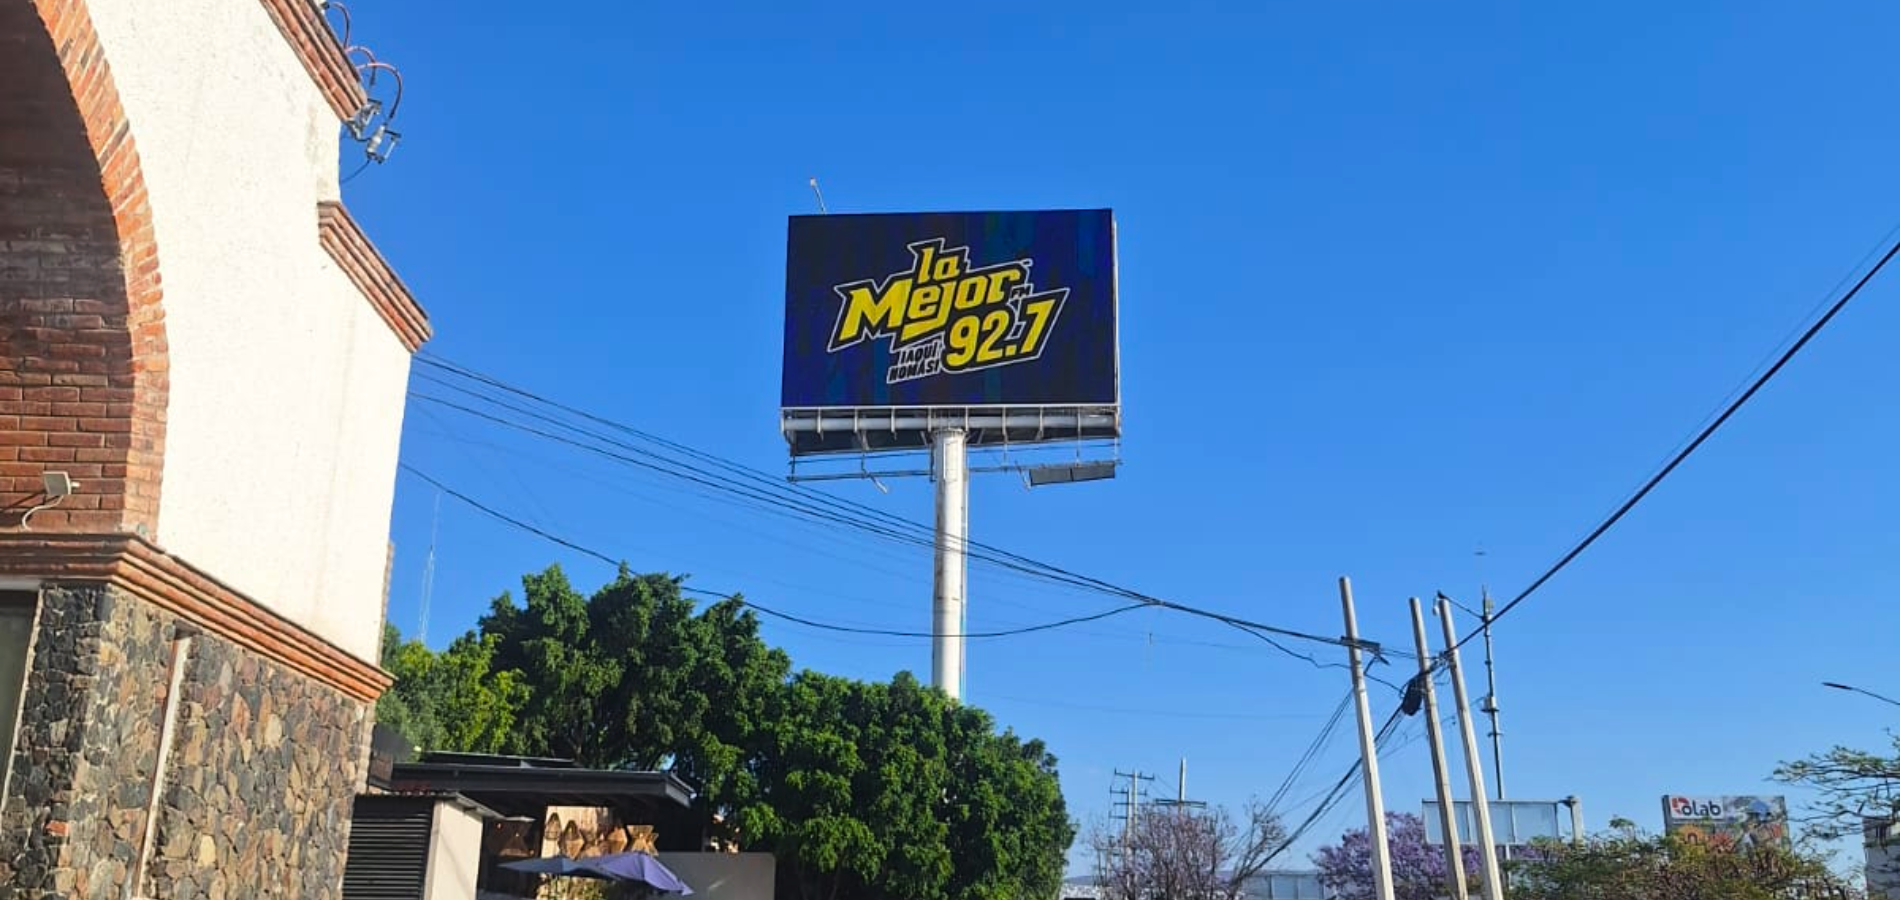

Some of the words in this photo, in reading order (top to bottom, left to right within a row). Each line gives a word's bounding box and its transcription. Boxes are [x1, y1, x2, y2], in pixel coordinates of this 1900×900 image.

[917, 247, 960, 284] la
[839, 268, 1021, 341] Mejor
[946, 299, 1054, 367] 92.7
